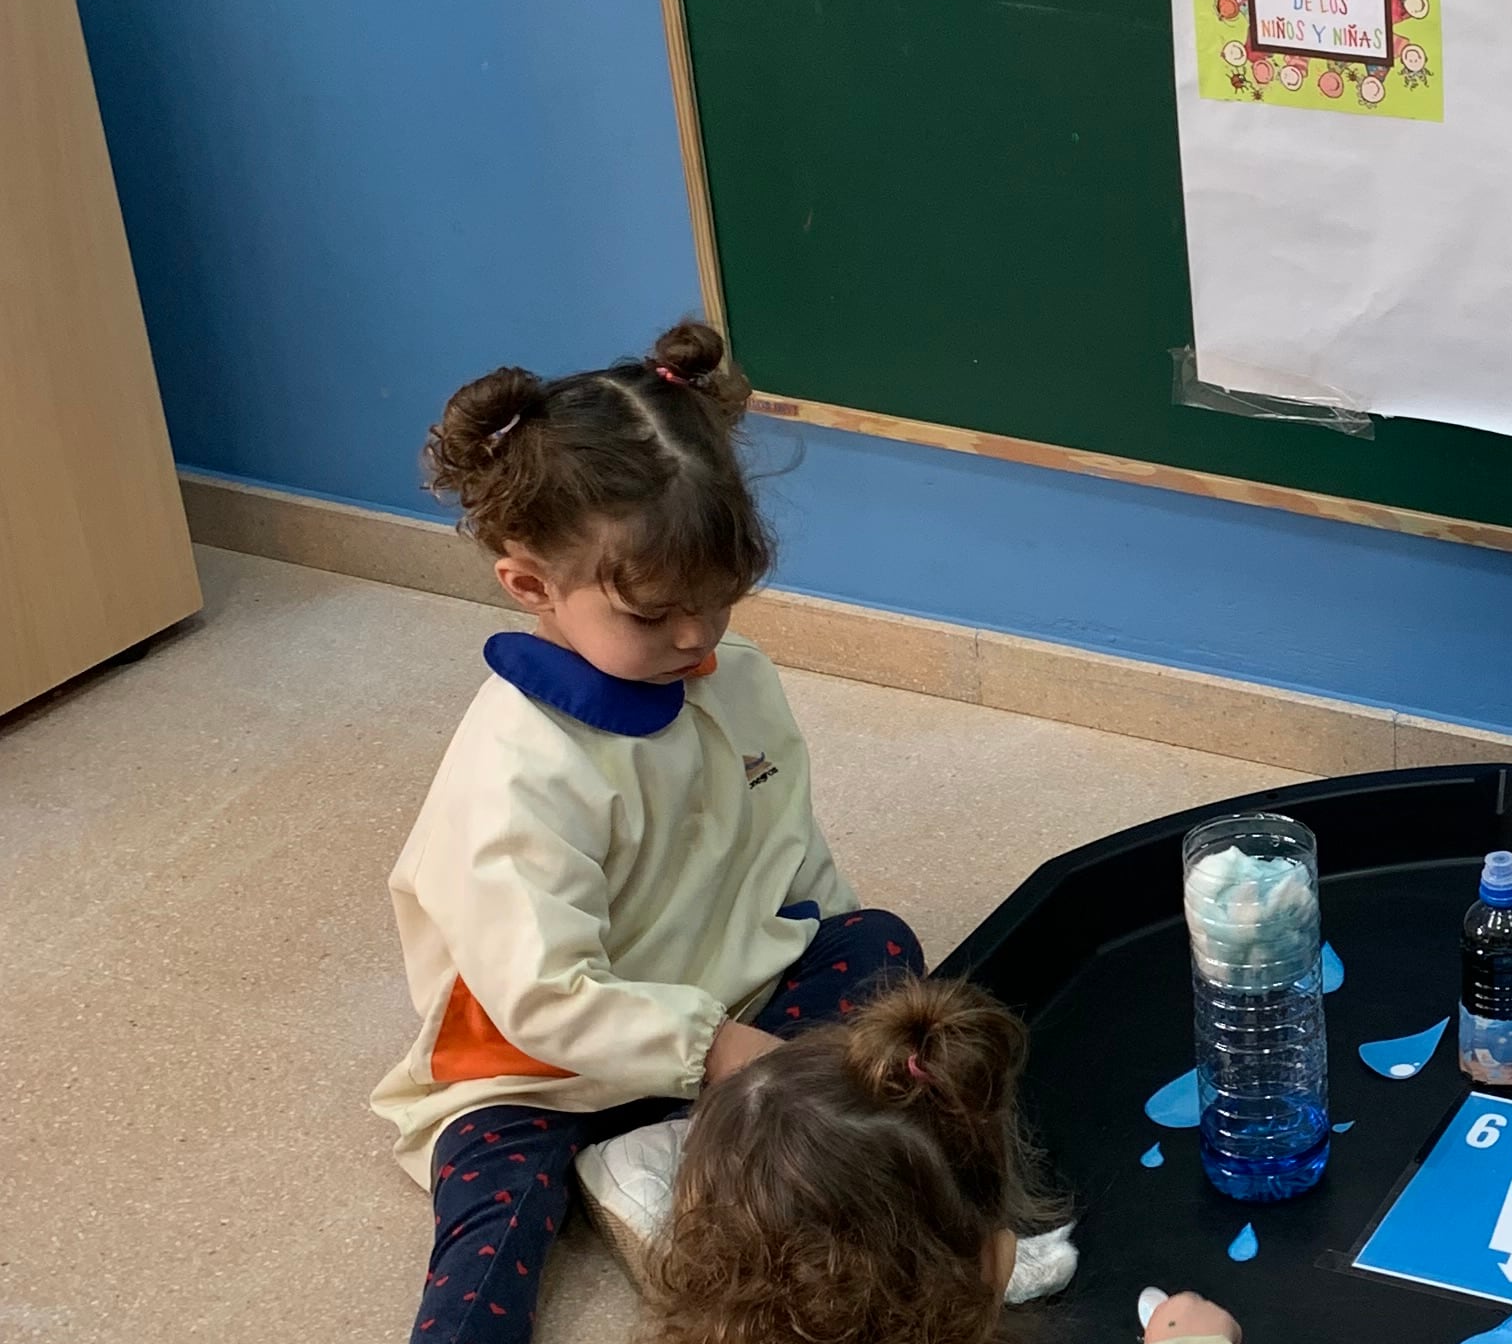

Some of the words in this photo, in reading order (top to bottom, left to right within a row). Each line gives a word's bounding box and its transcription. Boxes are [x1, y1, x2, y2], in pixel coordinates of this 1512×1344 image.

[1260, 16, 1306, 42] NIÑOS
[1311, 24, 1327, 45] Y
[1332, 23, 1383, 50] NIÑAS
[1465, 1112, 1508, 1150] 6
